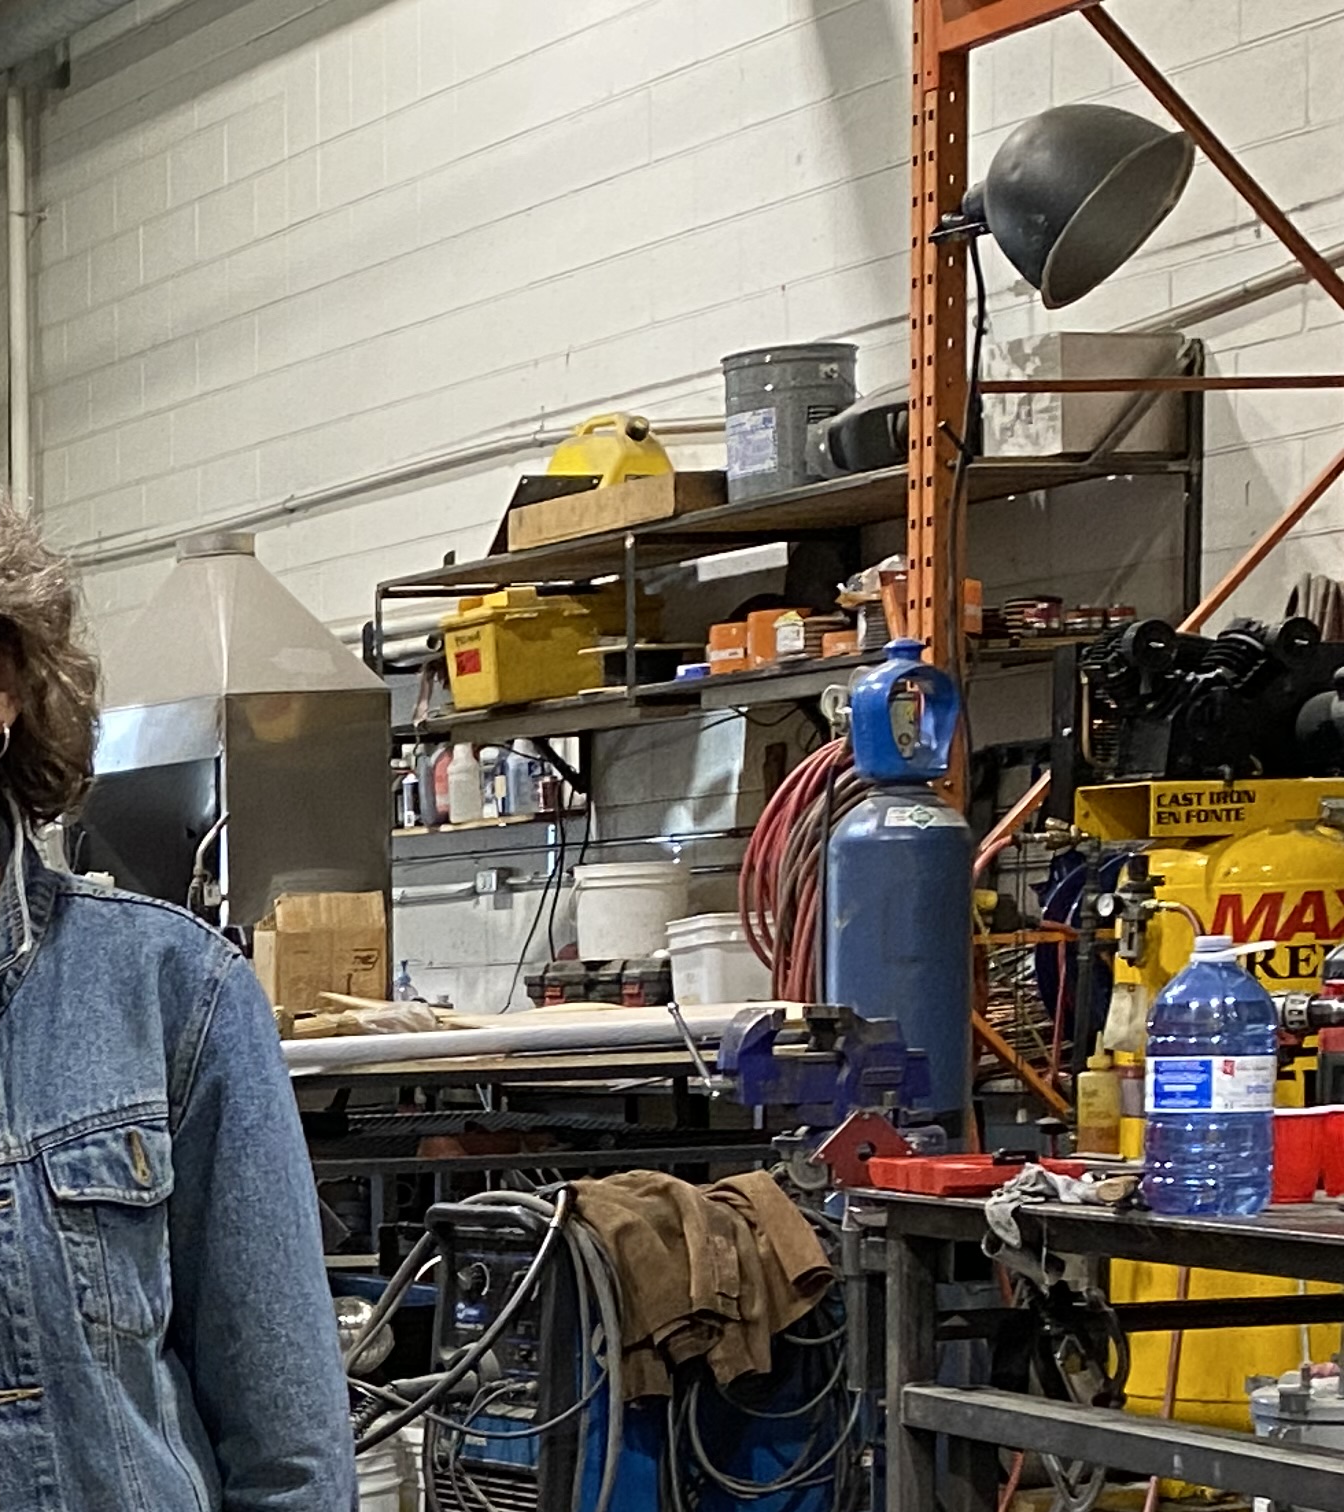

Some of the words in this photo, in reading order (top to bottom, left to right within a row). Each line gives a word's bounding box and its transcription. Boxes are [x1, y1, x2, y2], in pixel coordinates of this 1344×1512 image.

[1156, 791, 1205, 808] CAST
[1209, 789, 1256, 804] IRON
[1156, 810, 1180, 825] EN
[1185, 807, 1246, 824] FONTE
[1211, 888, 1344, 943] MA
